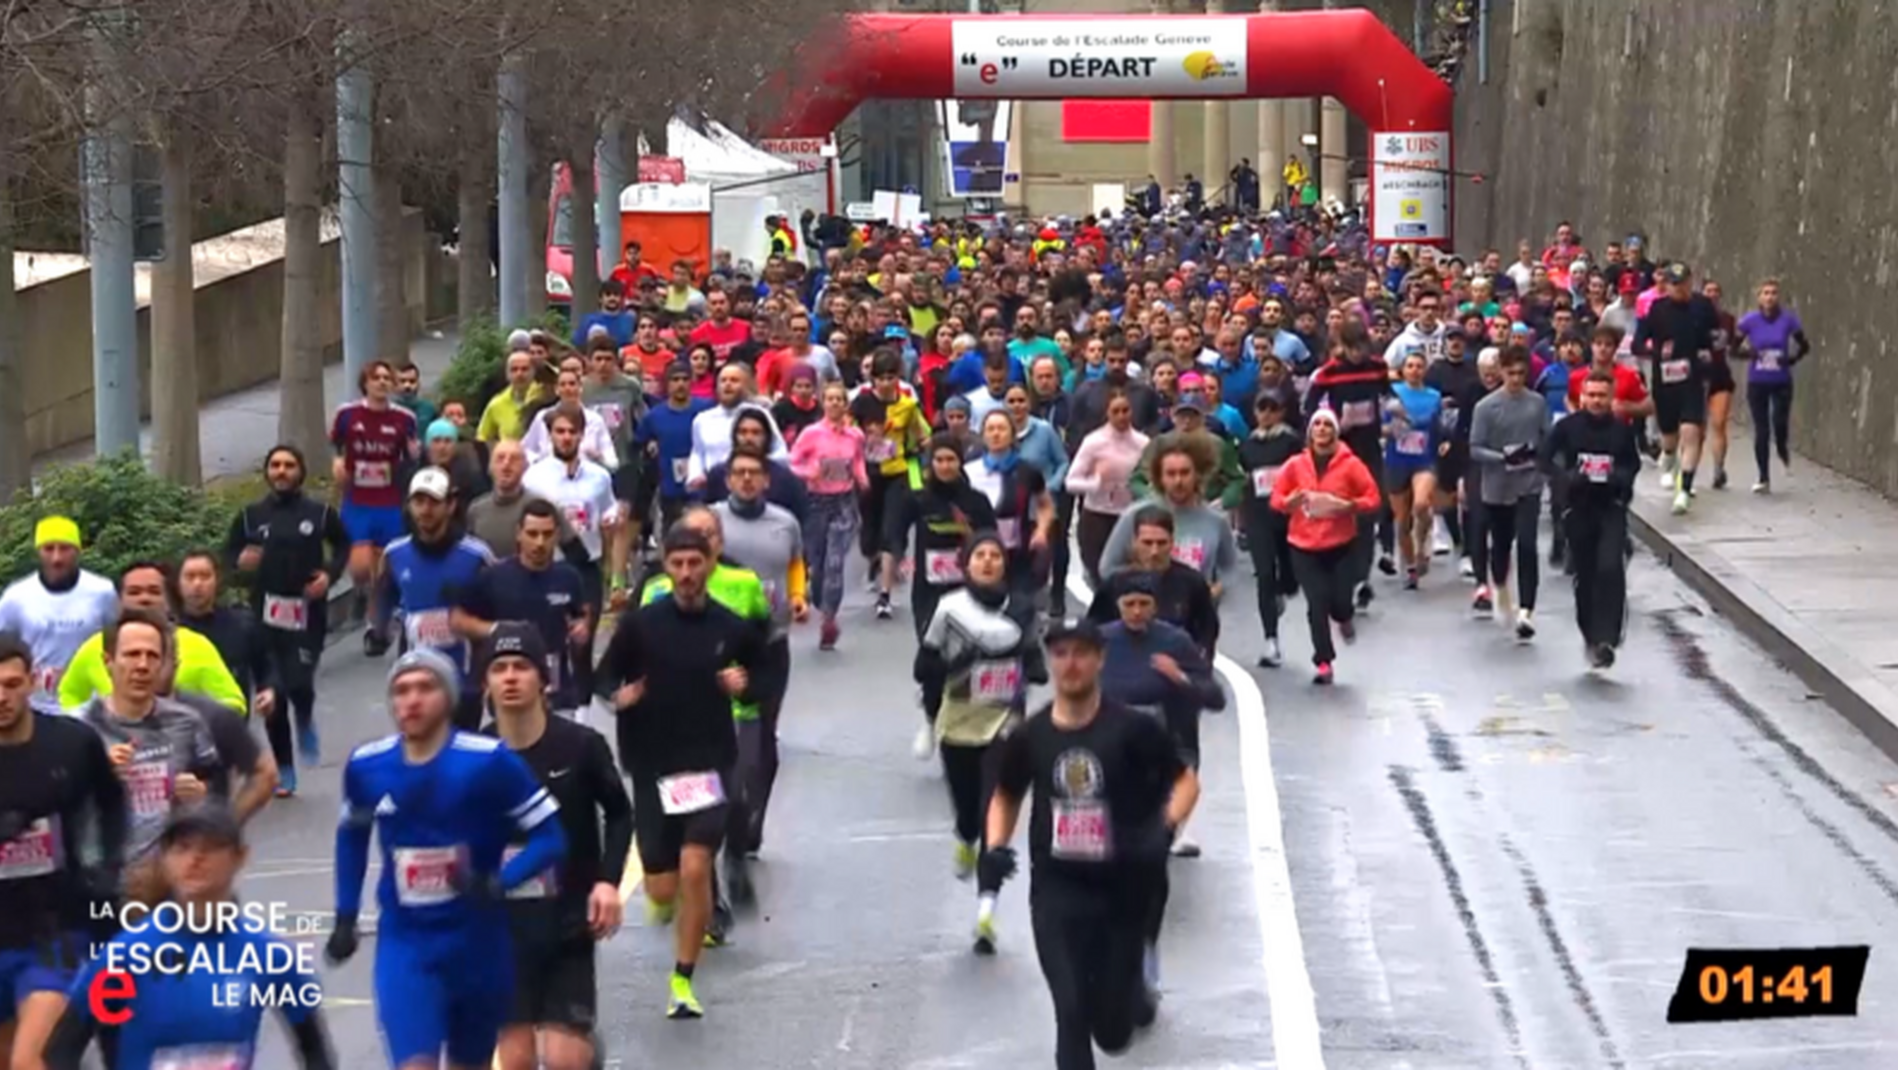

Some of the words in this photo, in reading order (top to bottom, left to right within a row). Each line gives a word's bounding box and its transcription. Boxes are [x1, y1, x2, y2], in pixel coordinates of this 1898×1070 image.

[996, 34, 1047, 47] Course
[1052, 34, 1070, 47] de
[1075, 34, 1148, 47] l'Escalade
[1049, 52, 1156, 78] DÉPART
[1406, 136, 1439, 153] UBS
